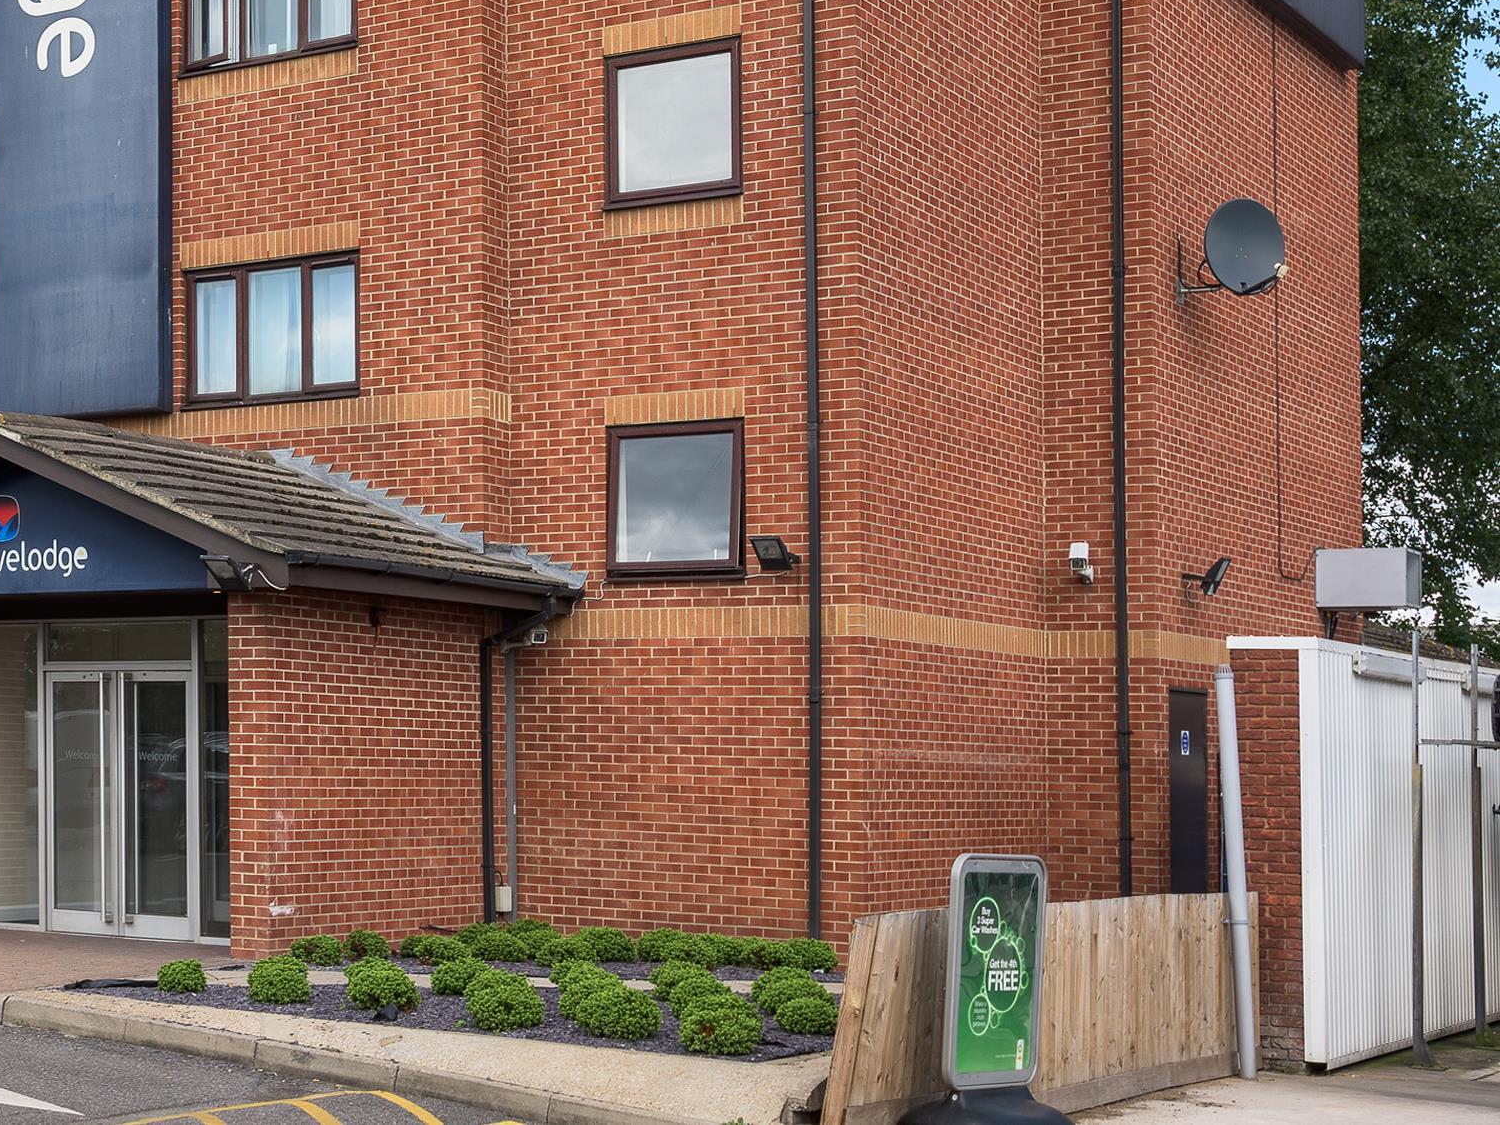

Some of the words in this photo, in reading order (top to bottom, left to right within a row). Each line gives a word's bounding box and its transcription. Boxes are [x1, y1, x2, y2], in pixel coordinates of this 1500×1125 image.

[139, 750, 178, 761] Welcome
[981, 906, 992, 916] Buy
[972, 925, 981, 934] Car
[989, 958, 1000, 969] Get
[1001, 958, 1009, 968] the
[1008, 958, 1018, 968] 4th
[987, 970, 1019, 992] FREE
